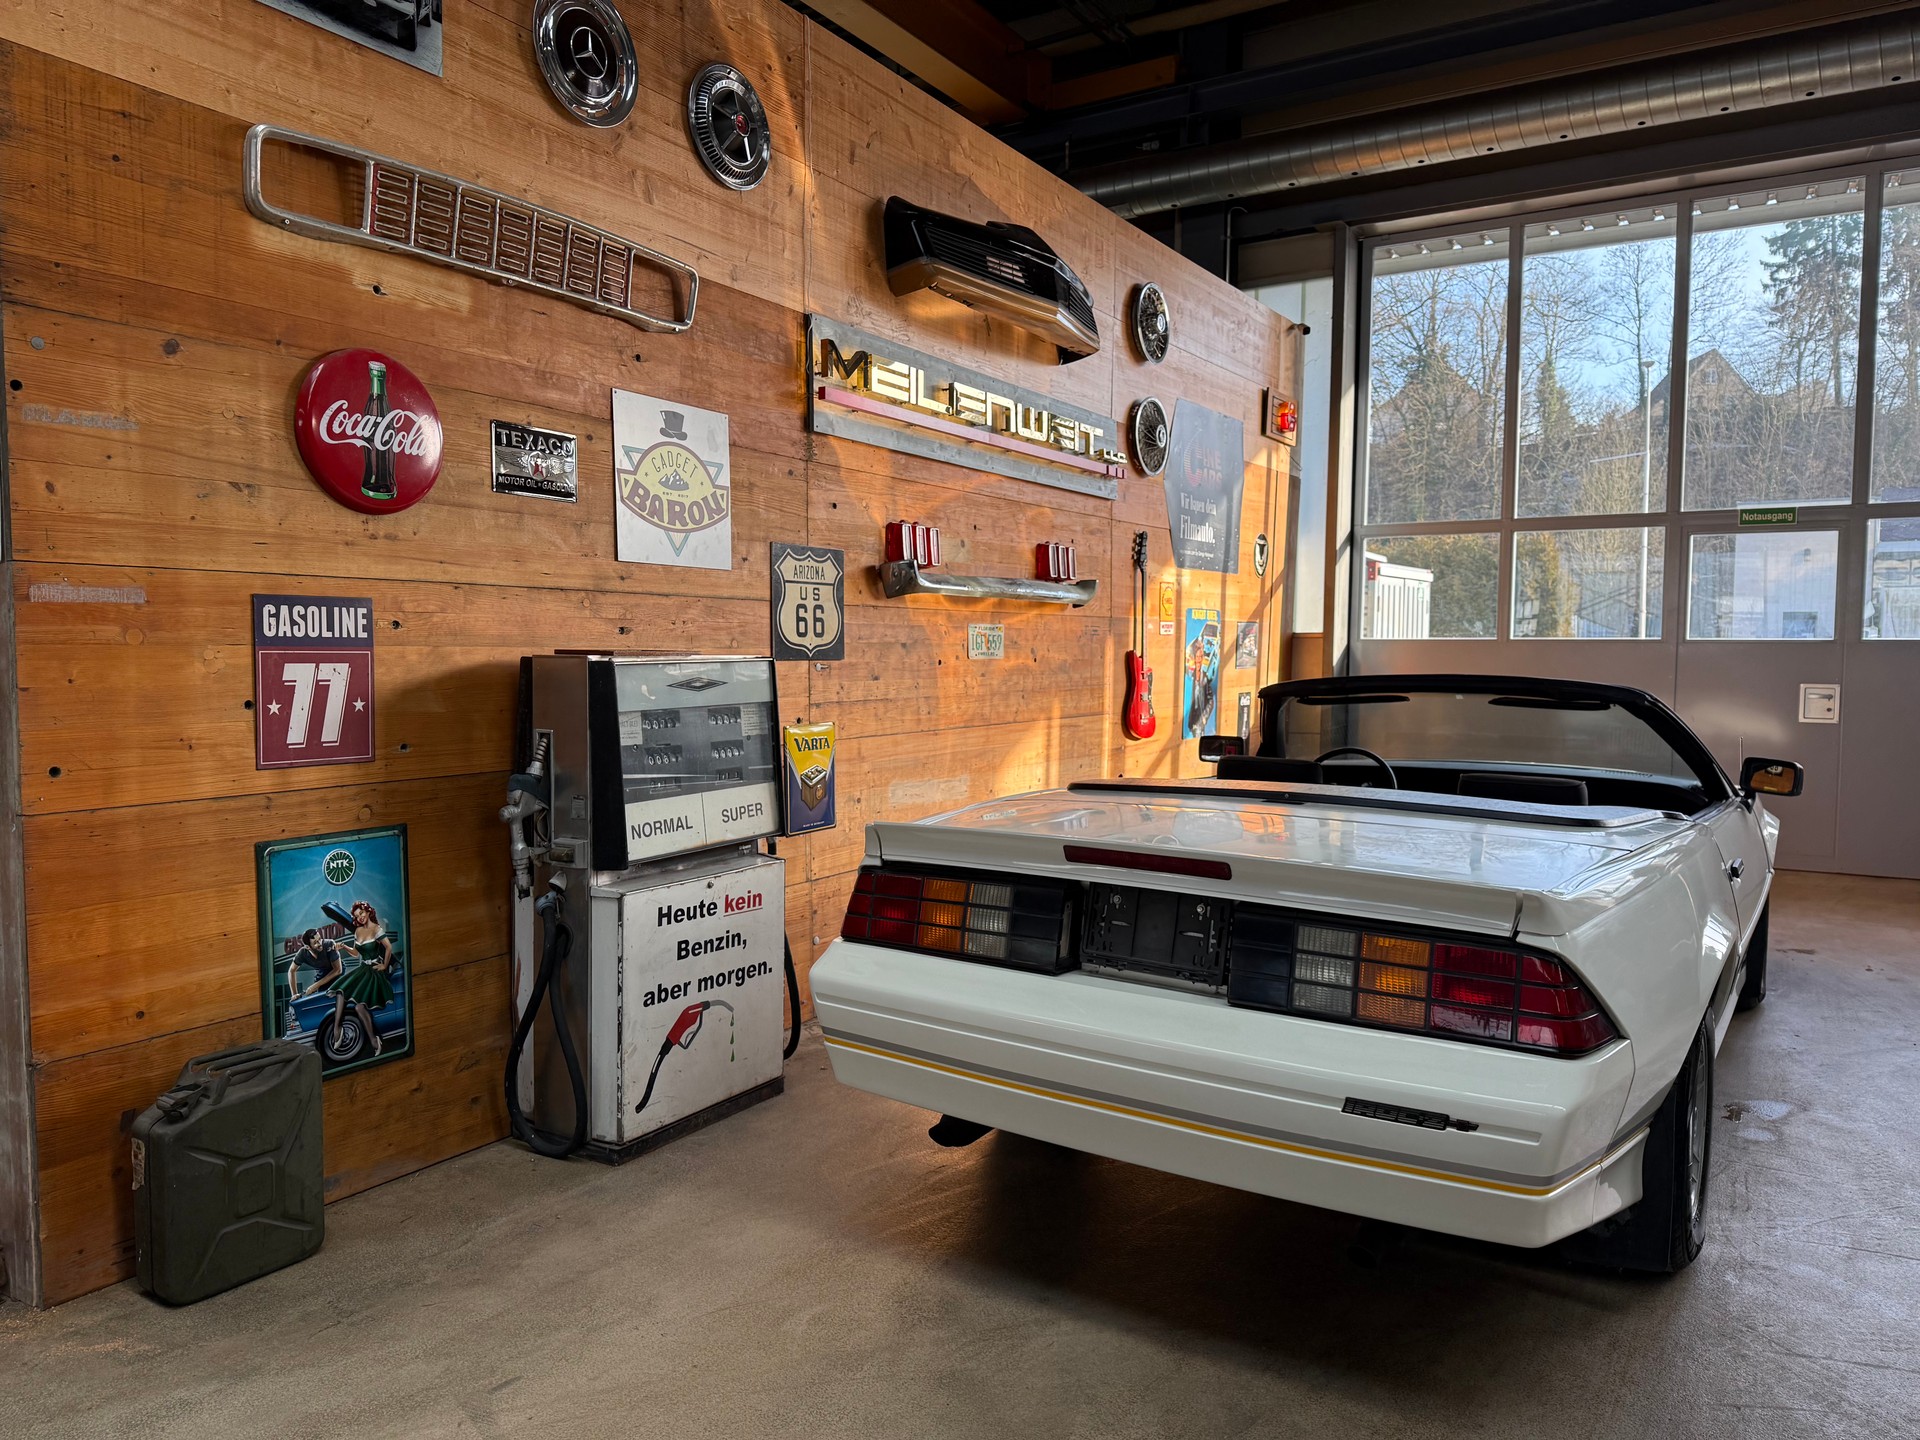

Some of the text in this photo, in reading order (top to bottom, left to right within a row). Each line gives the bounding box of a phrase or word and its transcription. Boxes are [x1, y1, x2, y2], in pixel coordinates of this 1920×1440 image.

[319, 400, 435, 457] Coca-Cola
[496, 428, 574, 457] TEXACO
[651, 450, 699, 479] GADGET
[498, 475, 576, 494] MOTOR OIL GASOLINE
[624, 477, 726, 528] BARON
[1742, 512, 1793, 522] Notausgang
[1180, 514, 1216, 544] Filmauto.
[793, 564, 826, 580] ARIZONA
[800, 586, 821, 602] US
[262, 603, 368, 639] GASOLINE
[796, 603, 825, 638] 66
[282, 662, 352, 749] 77
[793, 736, 831, 753] VARTA
[631, 802, 763, 840] NORMAL SUPER
[329, 859, 350, 869] NTK
[657, 890, 763, 927] Heute kein
[676, 930, 747, 961] Benzin,
[643, 960, 773, 1008] aber morgen.
